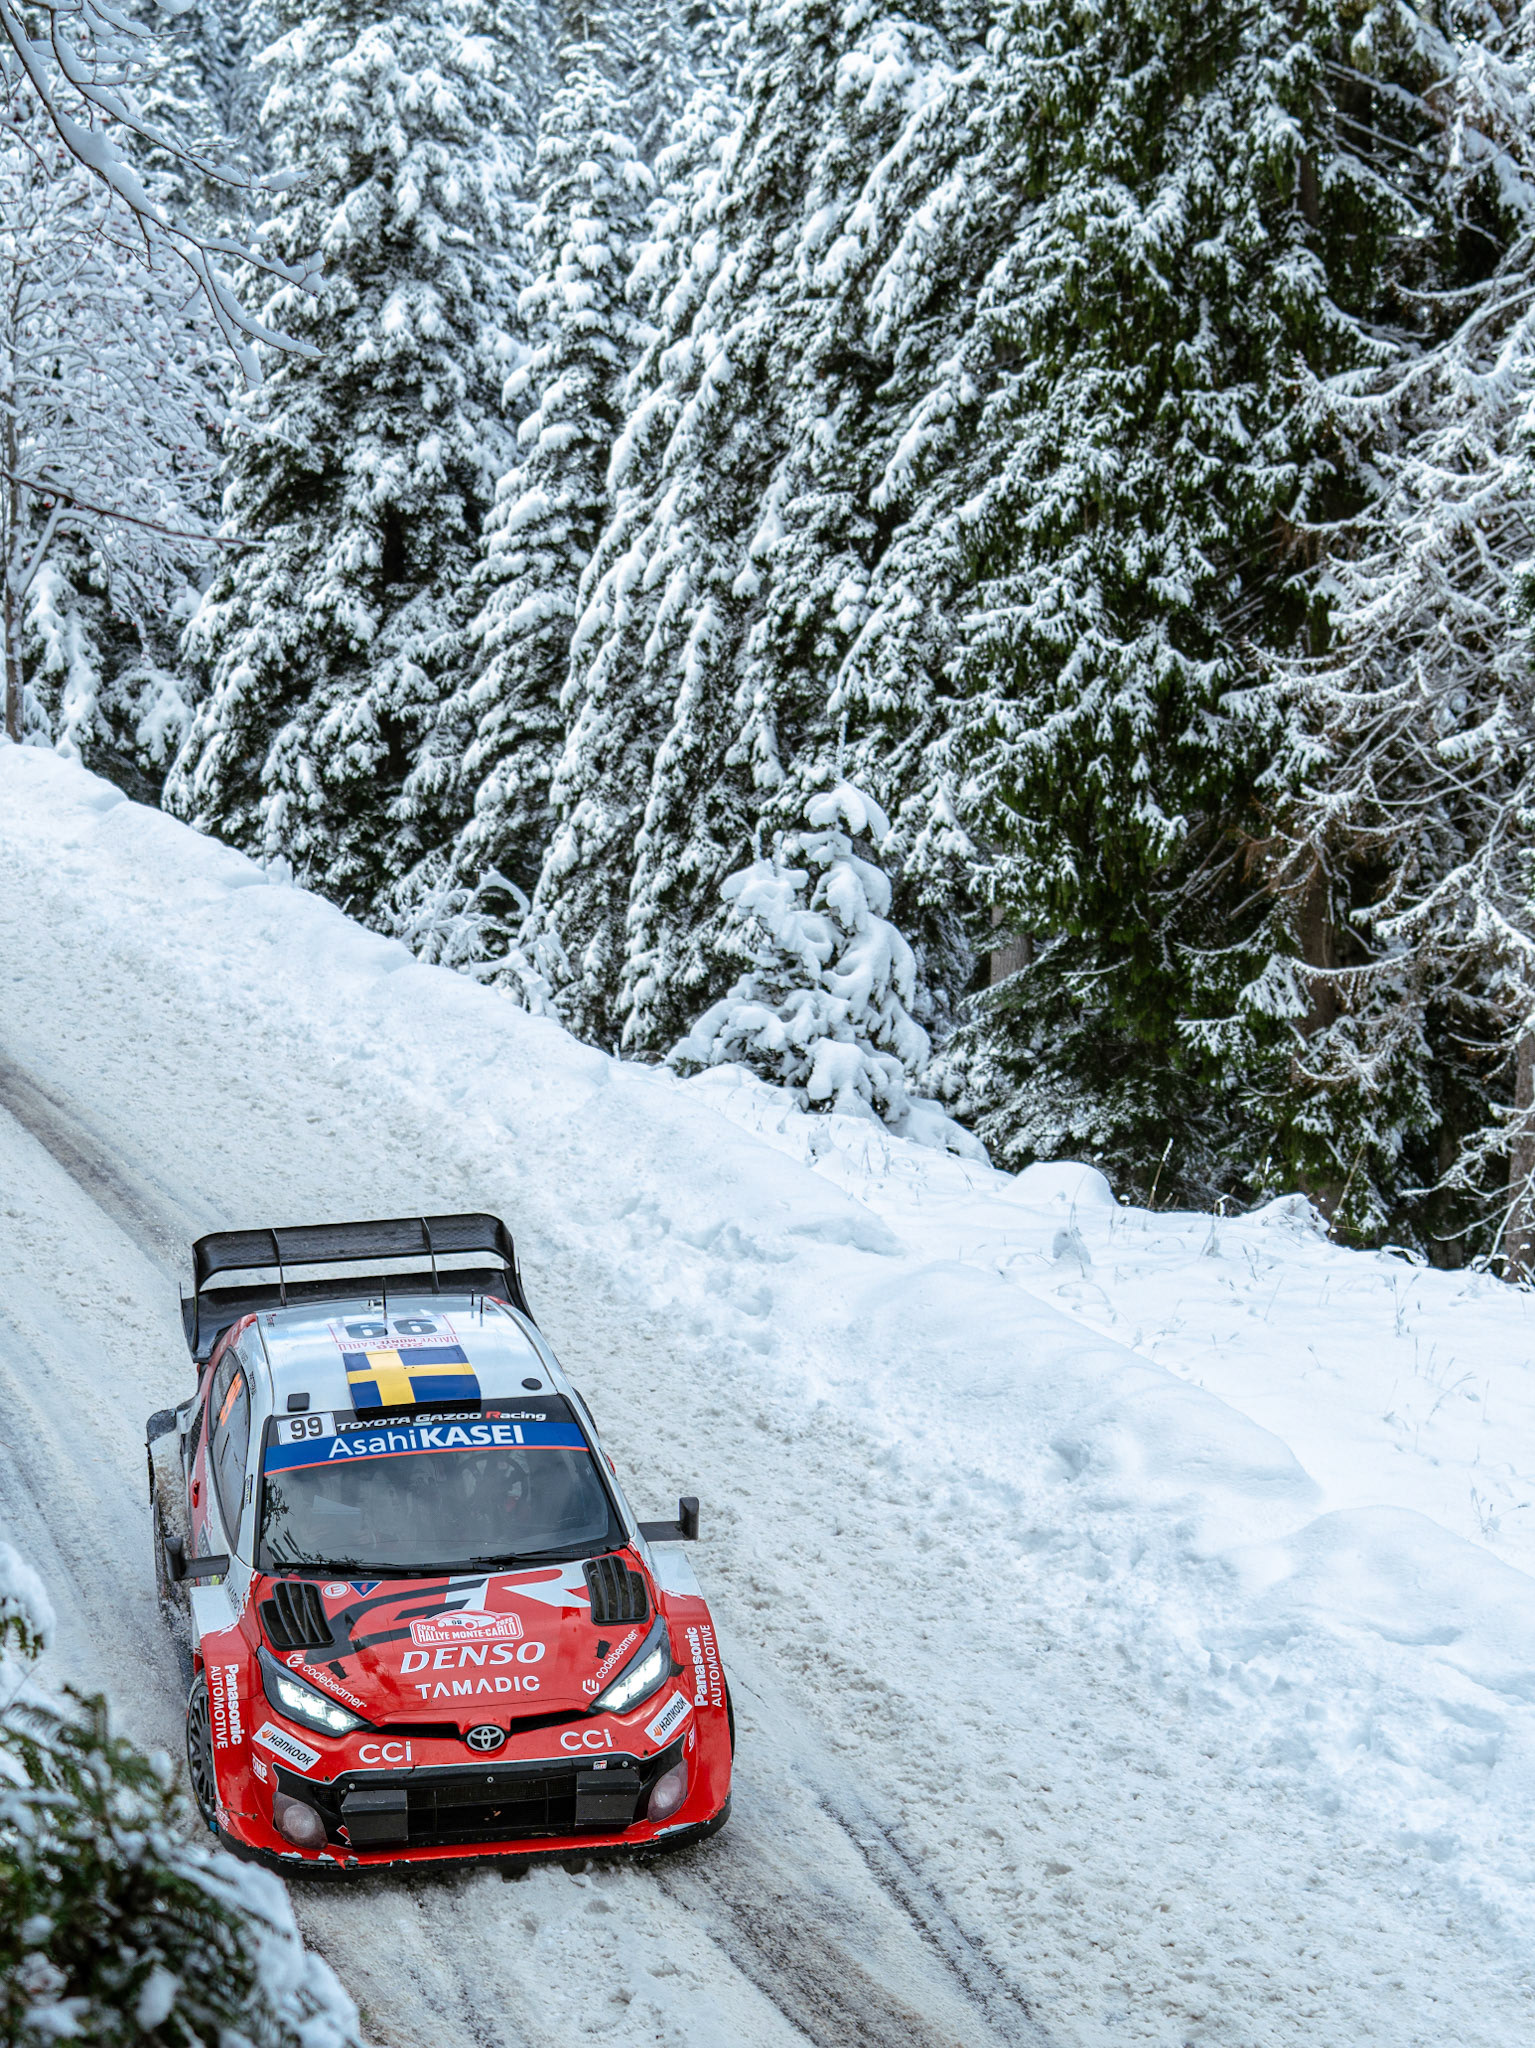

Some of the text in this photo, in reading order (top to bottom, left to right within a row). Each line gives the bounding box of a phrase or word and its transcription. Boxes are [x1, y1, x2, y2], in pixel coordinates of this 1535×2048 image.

[290, 1416, 323, 1440] 99
[336, 1410, 547, 1431] TOYOTA GAZOO Racing
[418, 1622, 517, 1643] RALLYE MONTE-CARLO
[596, 1629, 639, 1679] codebeamer
[400, 1641, 546, 1674] DENSO
[684, 1627, 709, 1707] Panasonic
[699, 1624, 723, 1708] AUTOMOTIVE
[210, 1665, 229, 1750] AUTOMOTIVE
[224, 1663, 245, 1745] Panasonic
[302, 1664, 367, 1709] codebeamer
[415, 1675, 540, 1700] TAMADIC
